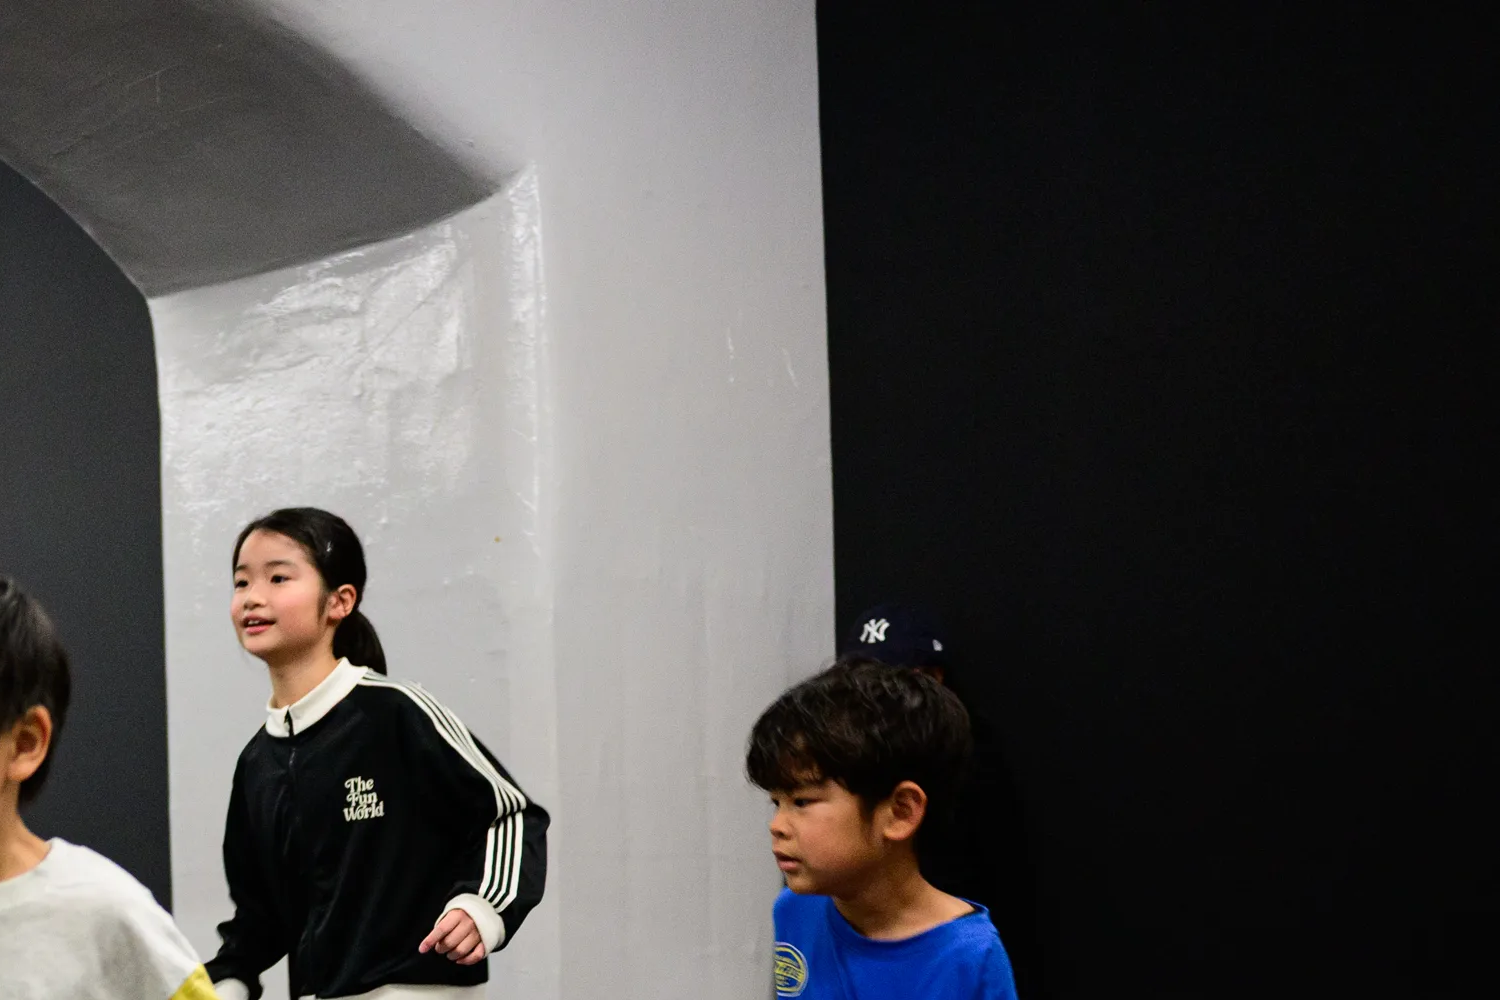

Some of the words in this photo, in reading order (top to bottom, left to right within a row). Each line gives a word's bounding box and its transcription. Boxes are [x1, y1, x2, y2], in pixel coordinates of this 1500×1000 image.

[859, 618, 890, 644] NY
[344, 776, 374, 793] The
[346, 791, 378, 807] Fun
[343, 800, 385, 822] World
